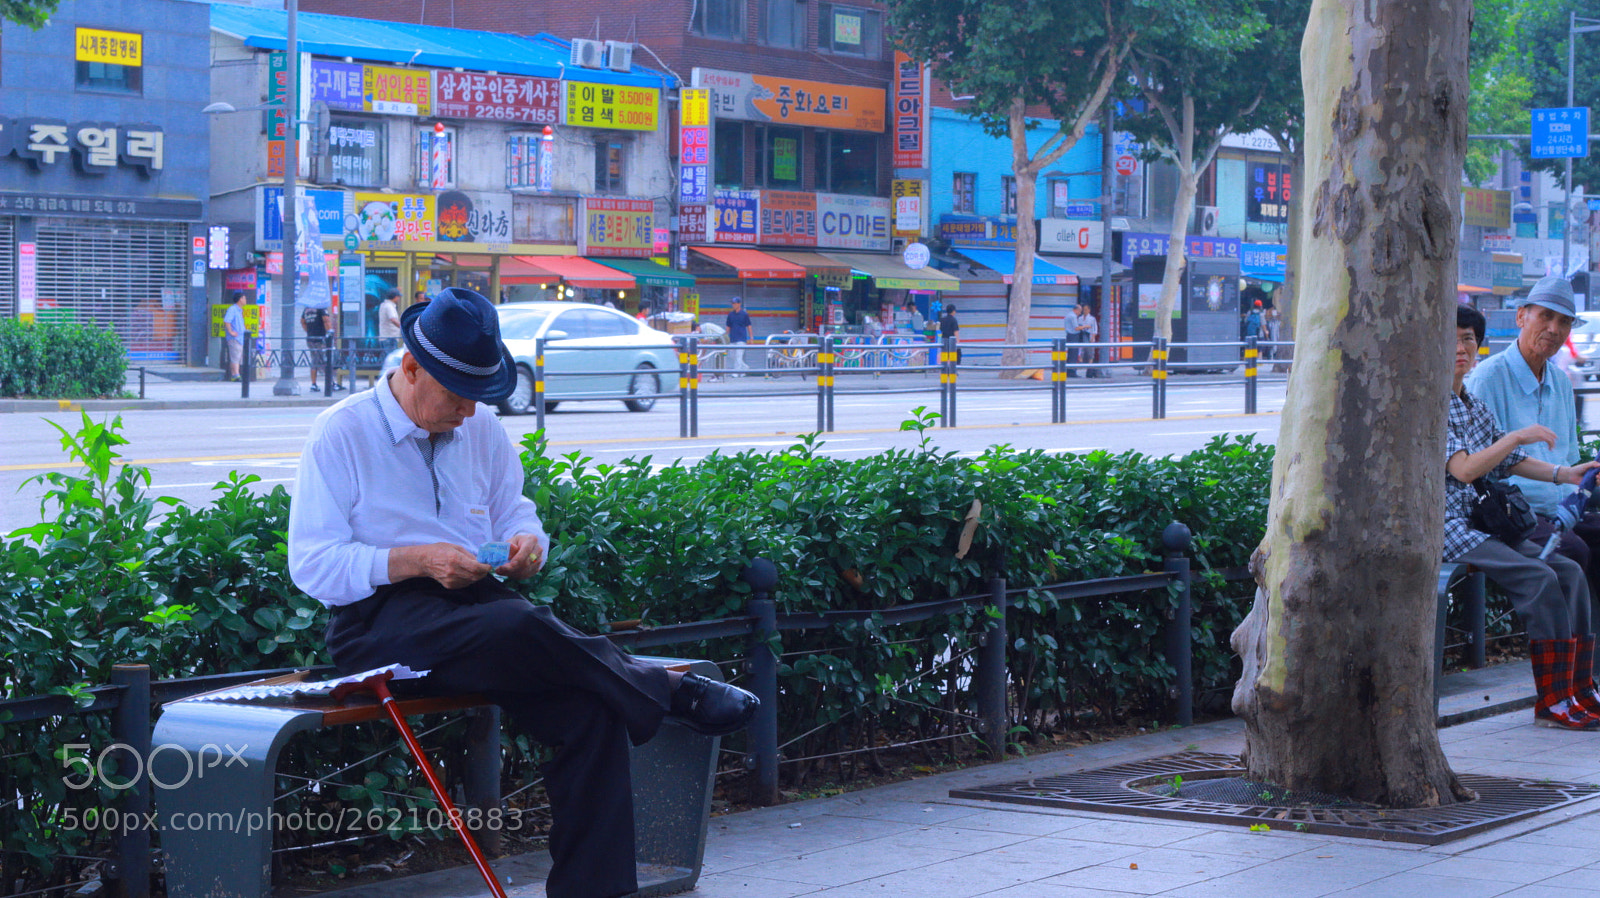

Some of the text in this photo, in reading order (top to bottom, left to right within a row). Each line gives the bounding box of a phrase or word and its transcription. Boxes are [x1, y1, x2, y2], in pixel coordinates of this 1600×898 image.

[79, 34, 138, 59] 시계종합병원
[375, 74, 429, 105] 성인용품
[439, 73, 549, 106] 삼성공인중개사
[618, 90, 653, 107] 3.500원
[776, 85, 848, 118] 중화요리
[475, 105, 556, 122] 2265-7155
[618, 111, 653, 126] 5.000원
[1537, 111, 1581, 122] 불법주차
[683, 129, 707, 145] 성인
[1547, 135, 1573, 144] 24시간
[332, 155, 372, 171] 인테리어
[680, 214, 705, 232] 부동산
[762, 207, 817, 237] 월드아크릴
[394, 220, 434, 242] 왕만두
[1056, 228, 1076, 242] olleh
